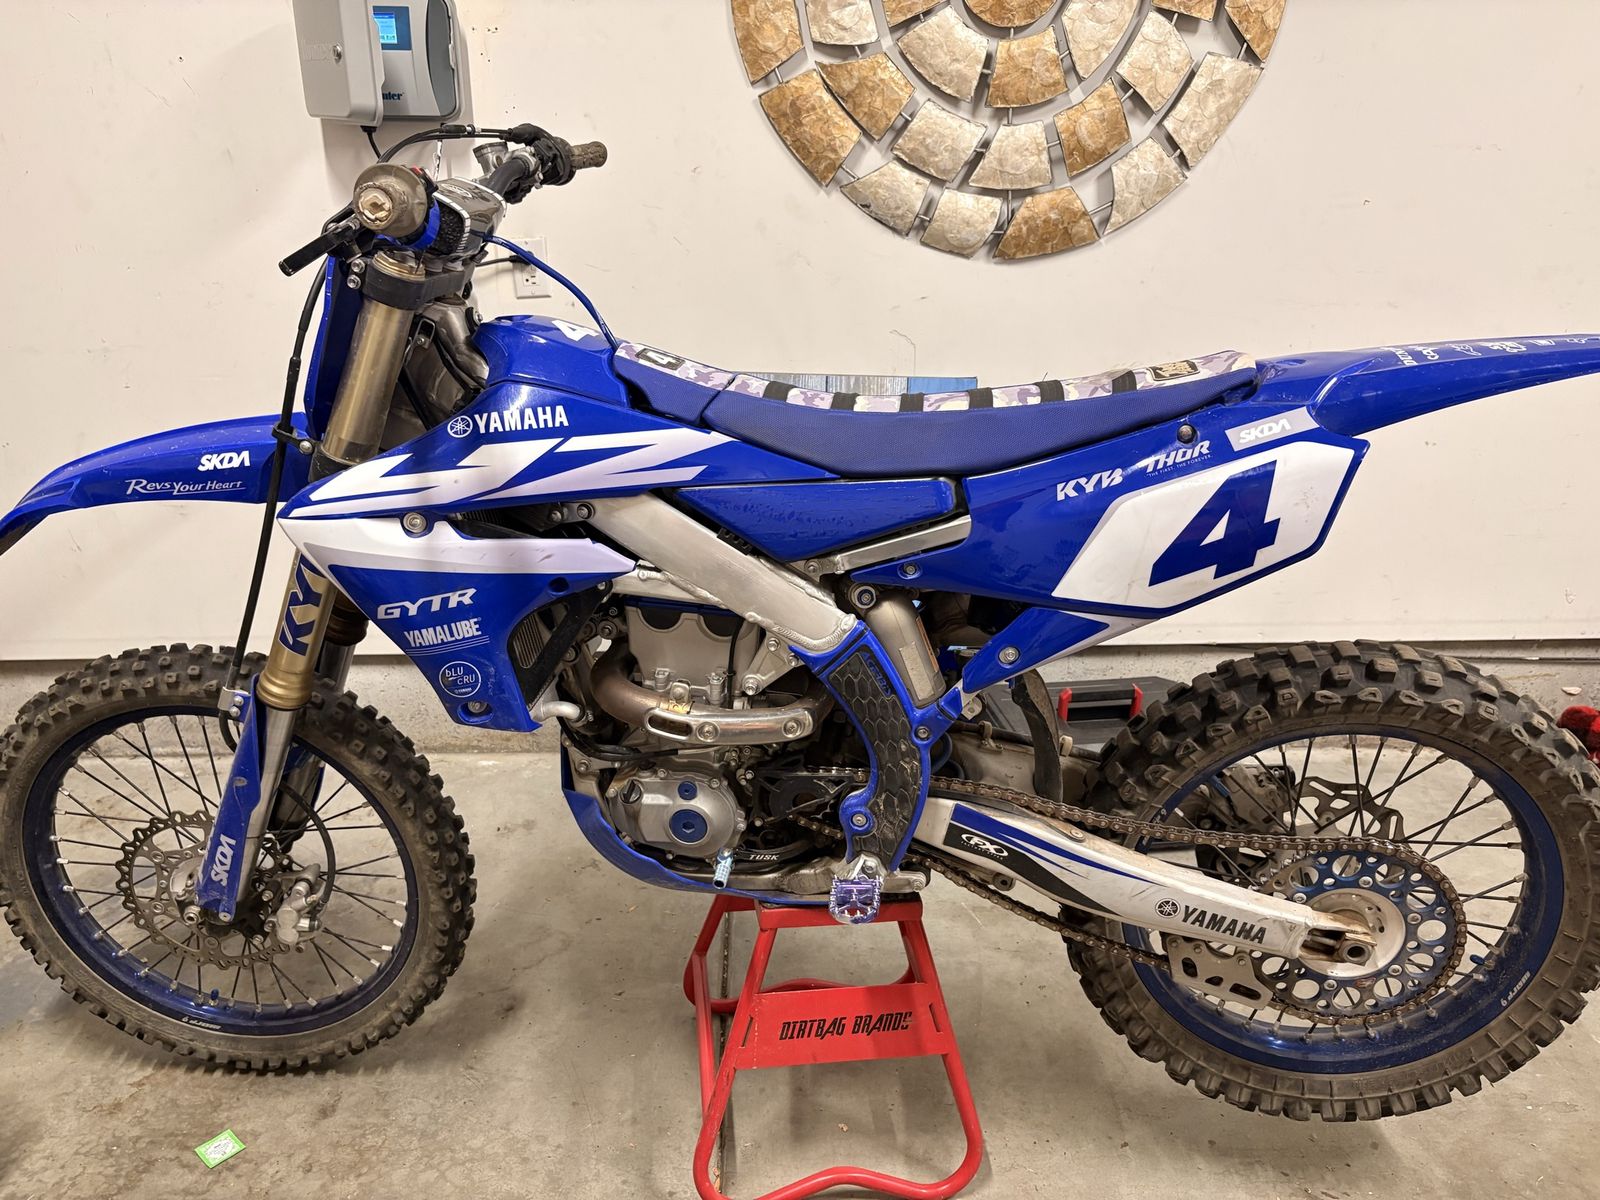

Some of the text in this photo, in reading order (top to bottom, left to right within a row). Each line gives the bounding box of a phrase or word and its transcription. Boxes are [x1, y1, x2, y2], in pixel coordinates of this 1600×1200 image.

[552, 319, 600, 342] 4
[646, 351, 677, 366] 4
[474, 405, 569, 434] YAMAHA
[1238, 418, 1291, 444] SKDA
[197, 450, 250, 471] SKDA
[1138, 440, 1210, 473] THOR
[1056, 467, 1123, 501] KYB
[1148, 459, 1281, 587] 4
[377, 587, 477, 619] GYTR
[404, 618, 482, 648] YAMALUBE
[211, 833, 237, 887] SKDA
[1182, 904, 1267, 944] YAMAHA
[779, 1011, 913, 1041] DIRTBAG BRANDS
